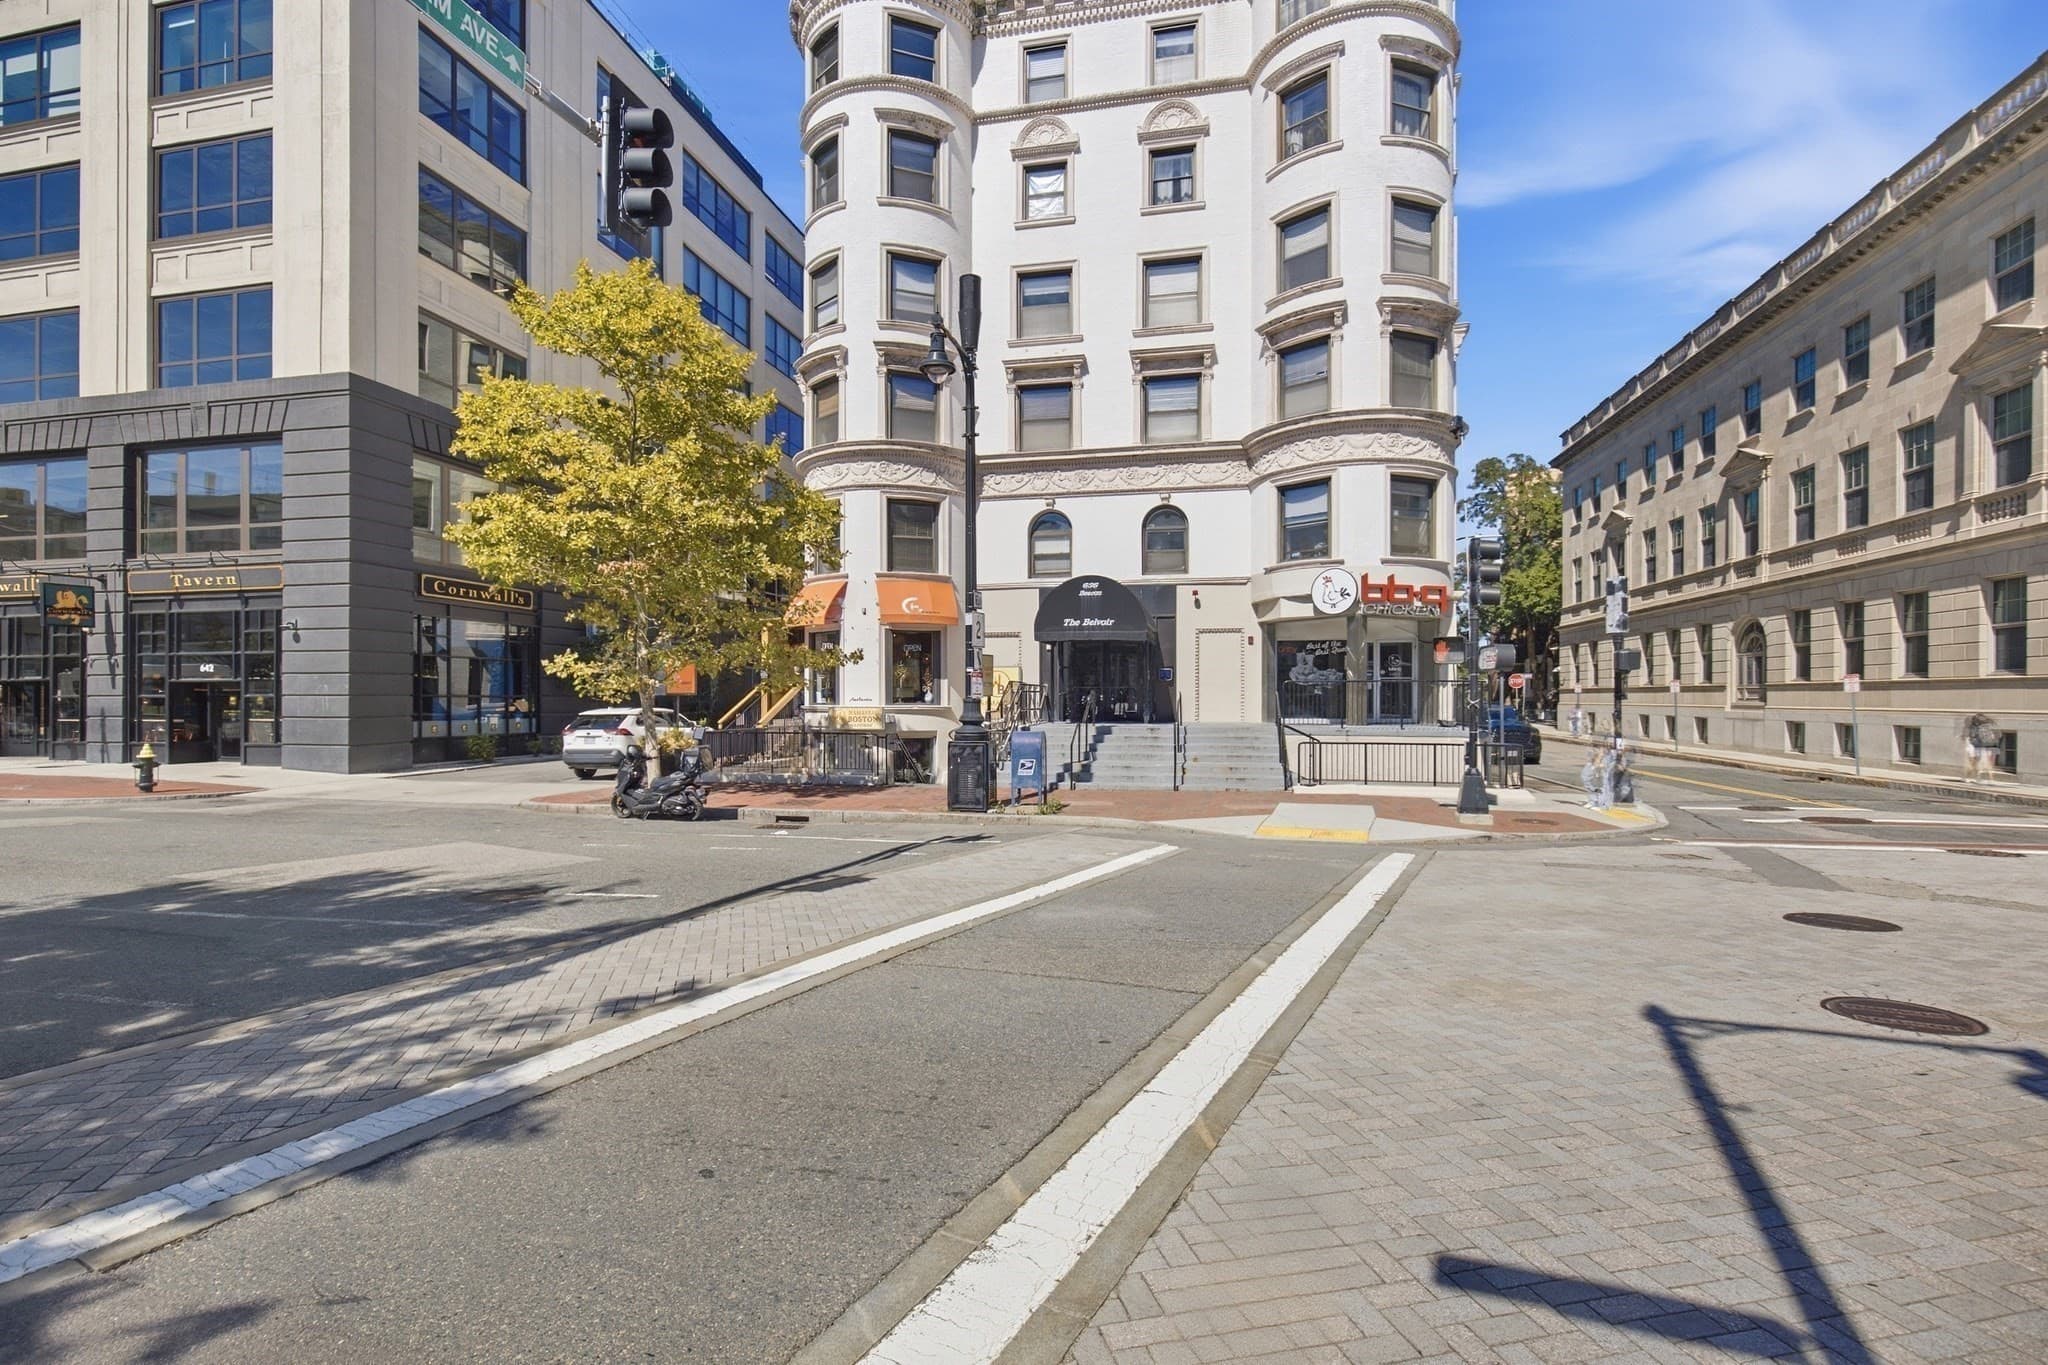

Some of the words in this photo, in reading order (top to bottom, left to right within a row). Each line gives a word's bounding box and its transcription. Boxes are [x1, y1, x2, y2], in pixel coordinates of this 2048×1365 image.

[460, 13, 499, 58] AVE
[170, 573, 237, 587] Tavern
[434, 580, 525, 605] Cornwall's
[1360, 603, 1440, 617] CHICKEN
[1063, 618, 1081, 627] The
[1082, 618, 1116, 627] Belvoir
[975, 620, 982, 640] 2
[200, 664, 214, 673] 642
